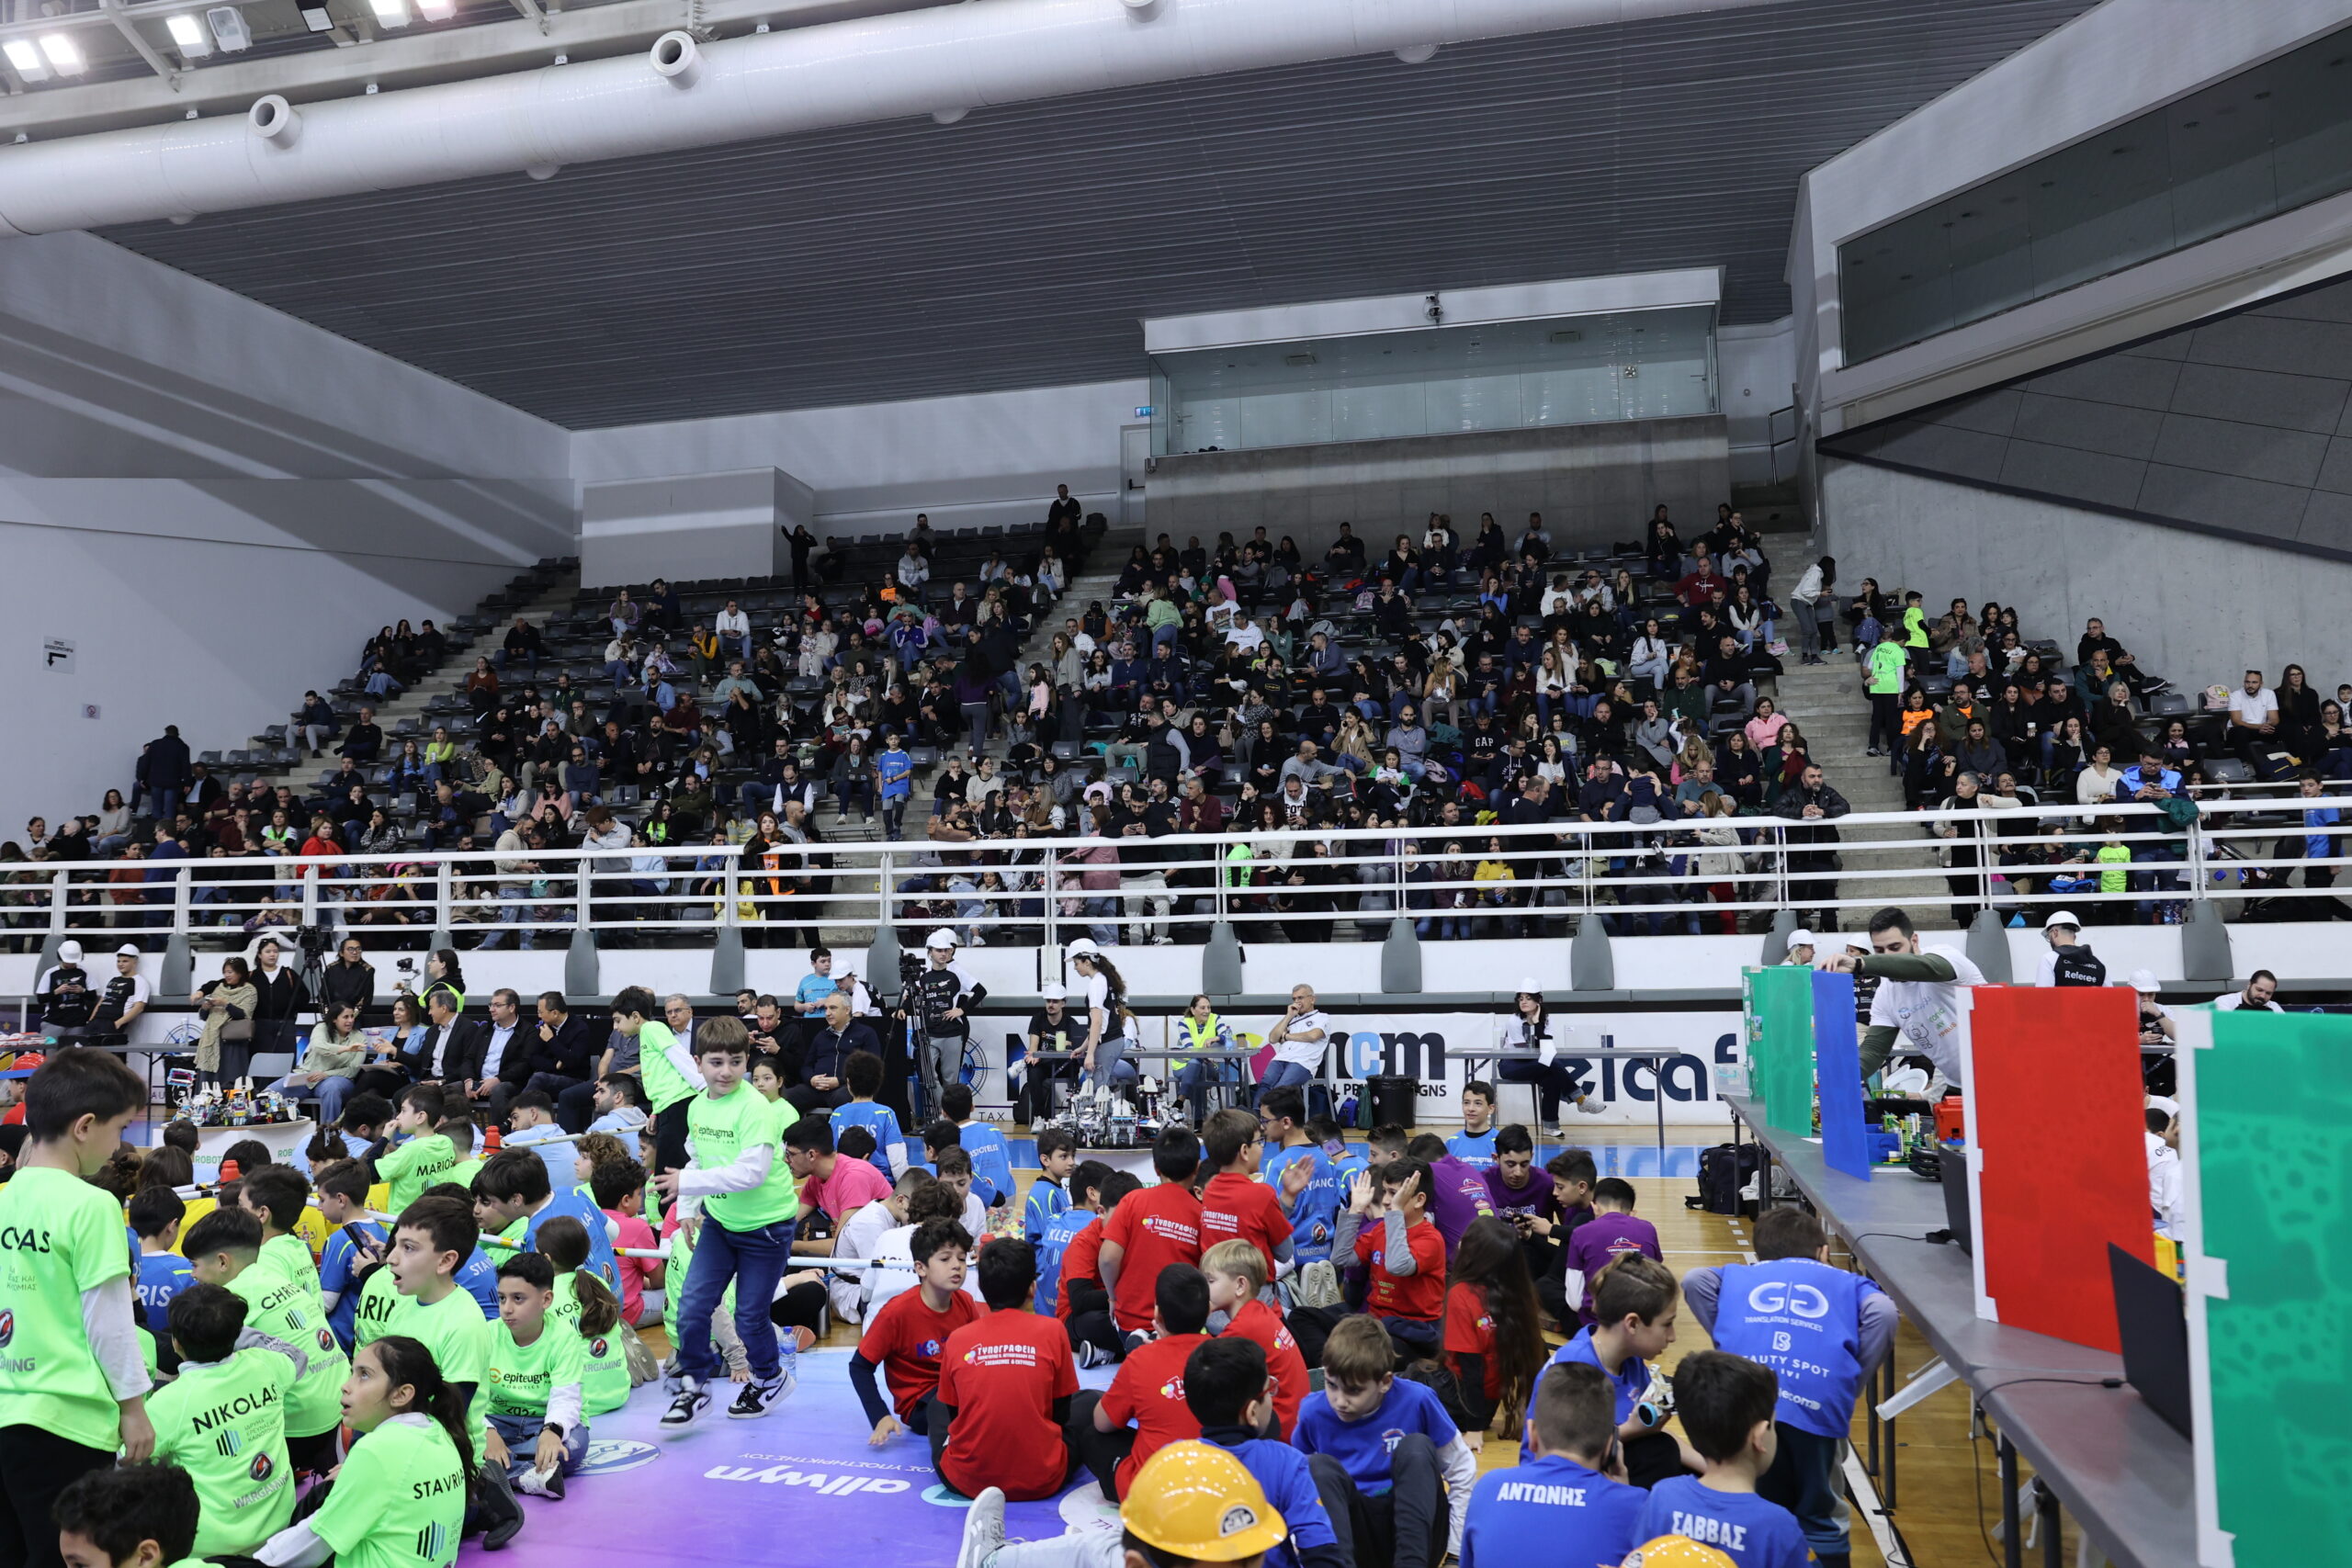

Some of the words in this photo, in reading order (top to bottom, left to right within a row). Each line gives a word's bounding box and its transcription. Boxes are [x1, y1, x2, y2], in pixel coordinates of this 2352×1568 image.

[1476, 737, 1494, 748] GAP
[2064, 971, 2097, 983] Referee
[1315, 1032, 1445, 1080] ncm
[978, 1112, 1005, 1122] TAX
[698, 1126, 734, 1139] epiteugma
[416, 1156, 456, 1177] MARIOS
[1048, 1228, 1077, 1243] KLEI
[555, 1301, 580, 1317] KOS
[1790, 1318, 1824, 1332] SERVICES
[978, 1344, 1035, 1355] ΤΥΠΟΓΡΑΦΕΙΑ
[1743, 1355, 1788, 1364] AUTY
[1792, 1359, 1830, 1378] SPOT
[192, 1382, 277, 1436] NIKOLAS
[778, 1454, 902, 1471] ΥΠΟΣΤΗΡΙΚΤΗΣ
[704, 1464, 911, 1496] allwyn
[1497, 1482, 1587, 1506] ΑΝΤΩΝΗΣ
[1671, 1511, 1747, 1551] ΣΑΒΒΑΣ
